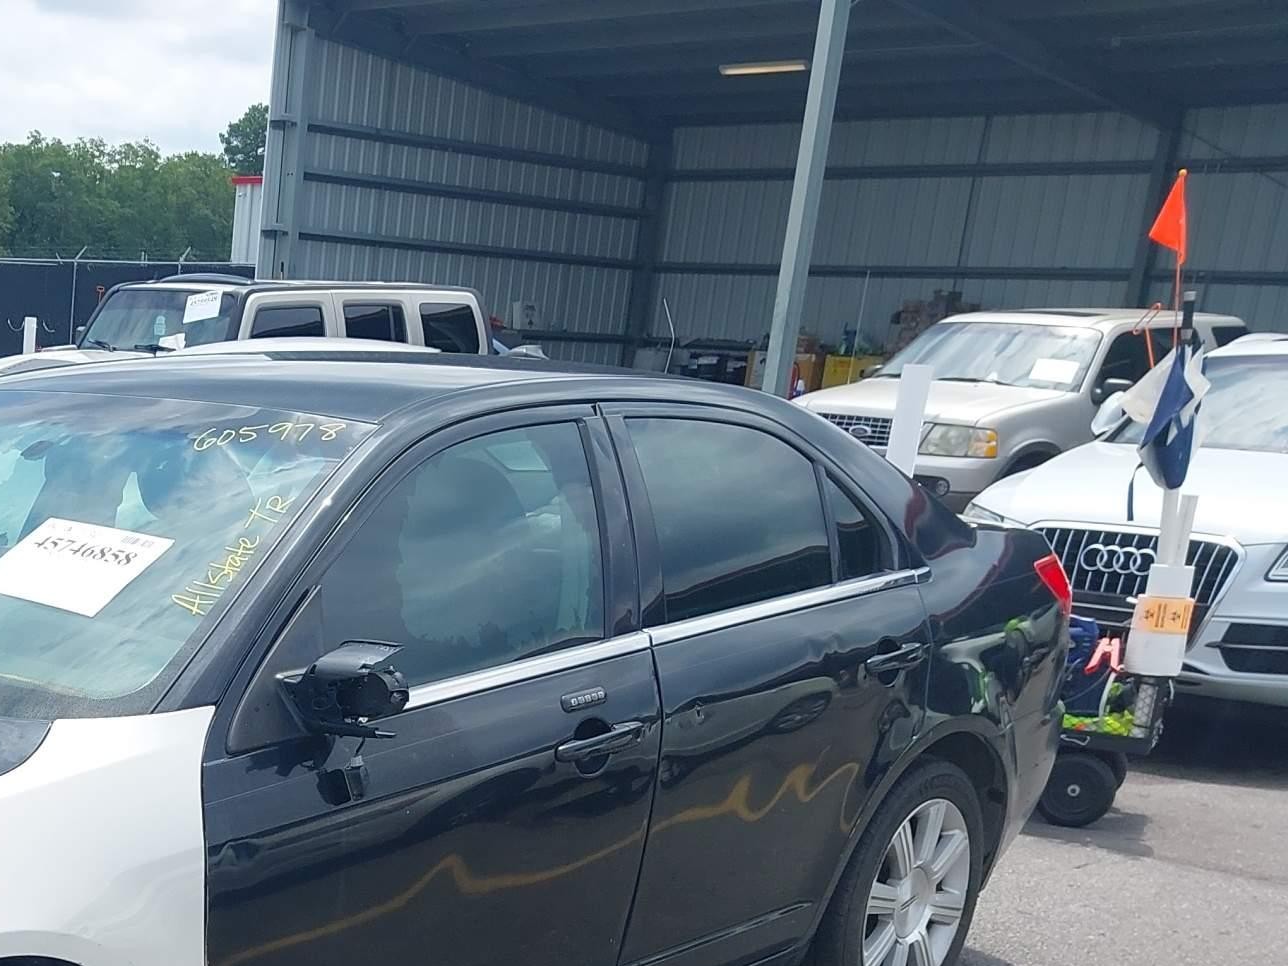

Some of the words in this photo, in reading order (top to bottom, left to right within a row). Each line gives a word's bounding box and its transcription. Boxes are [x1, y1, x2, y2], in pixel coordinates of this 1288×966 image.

[193, 422, 347, 451] 605978
[244, 494, 296, 529] TR
[34, 536, 138, 566] 45746858
